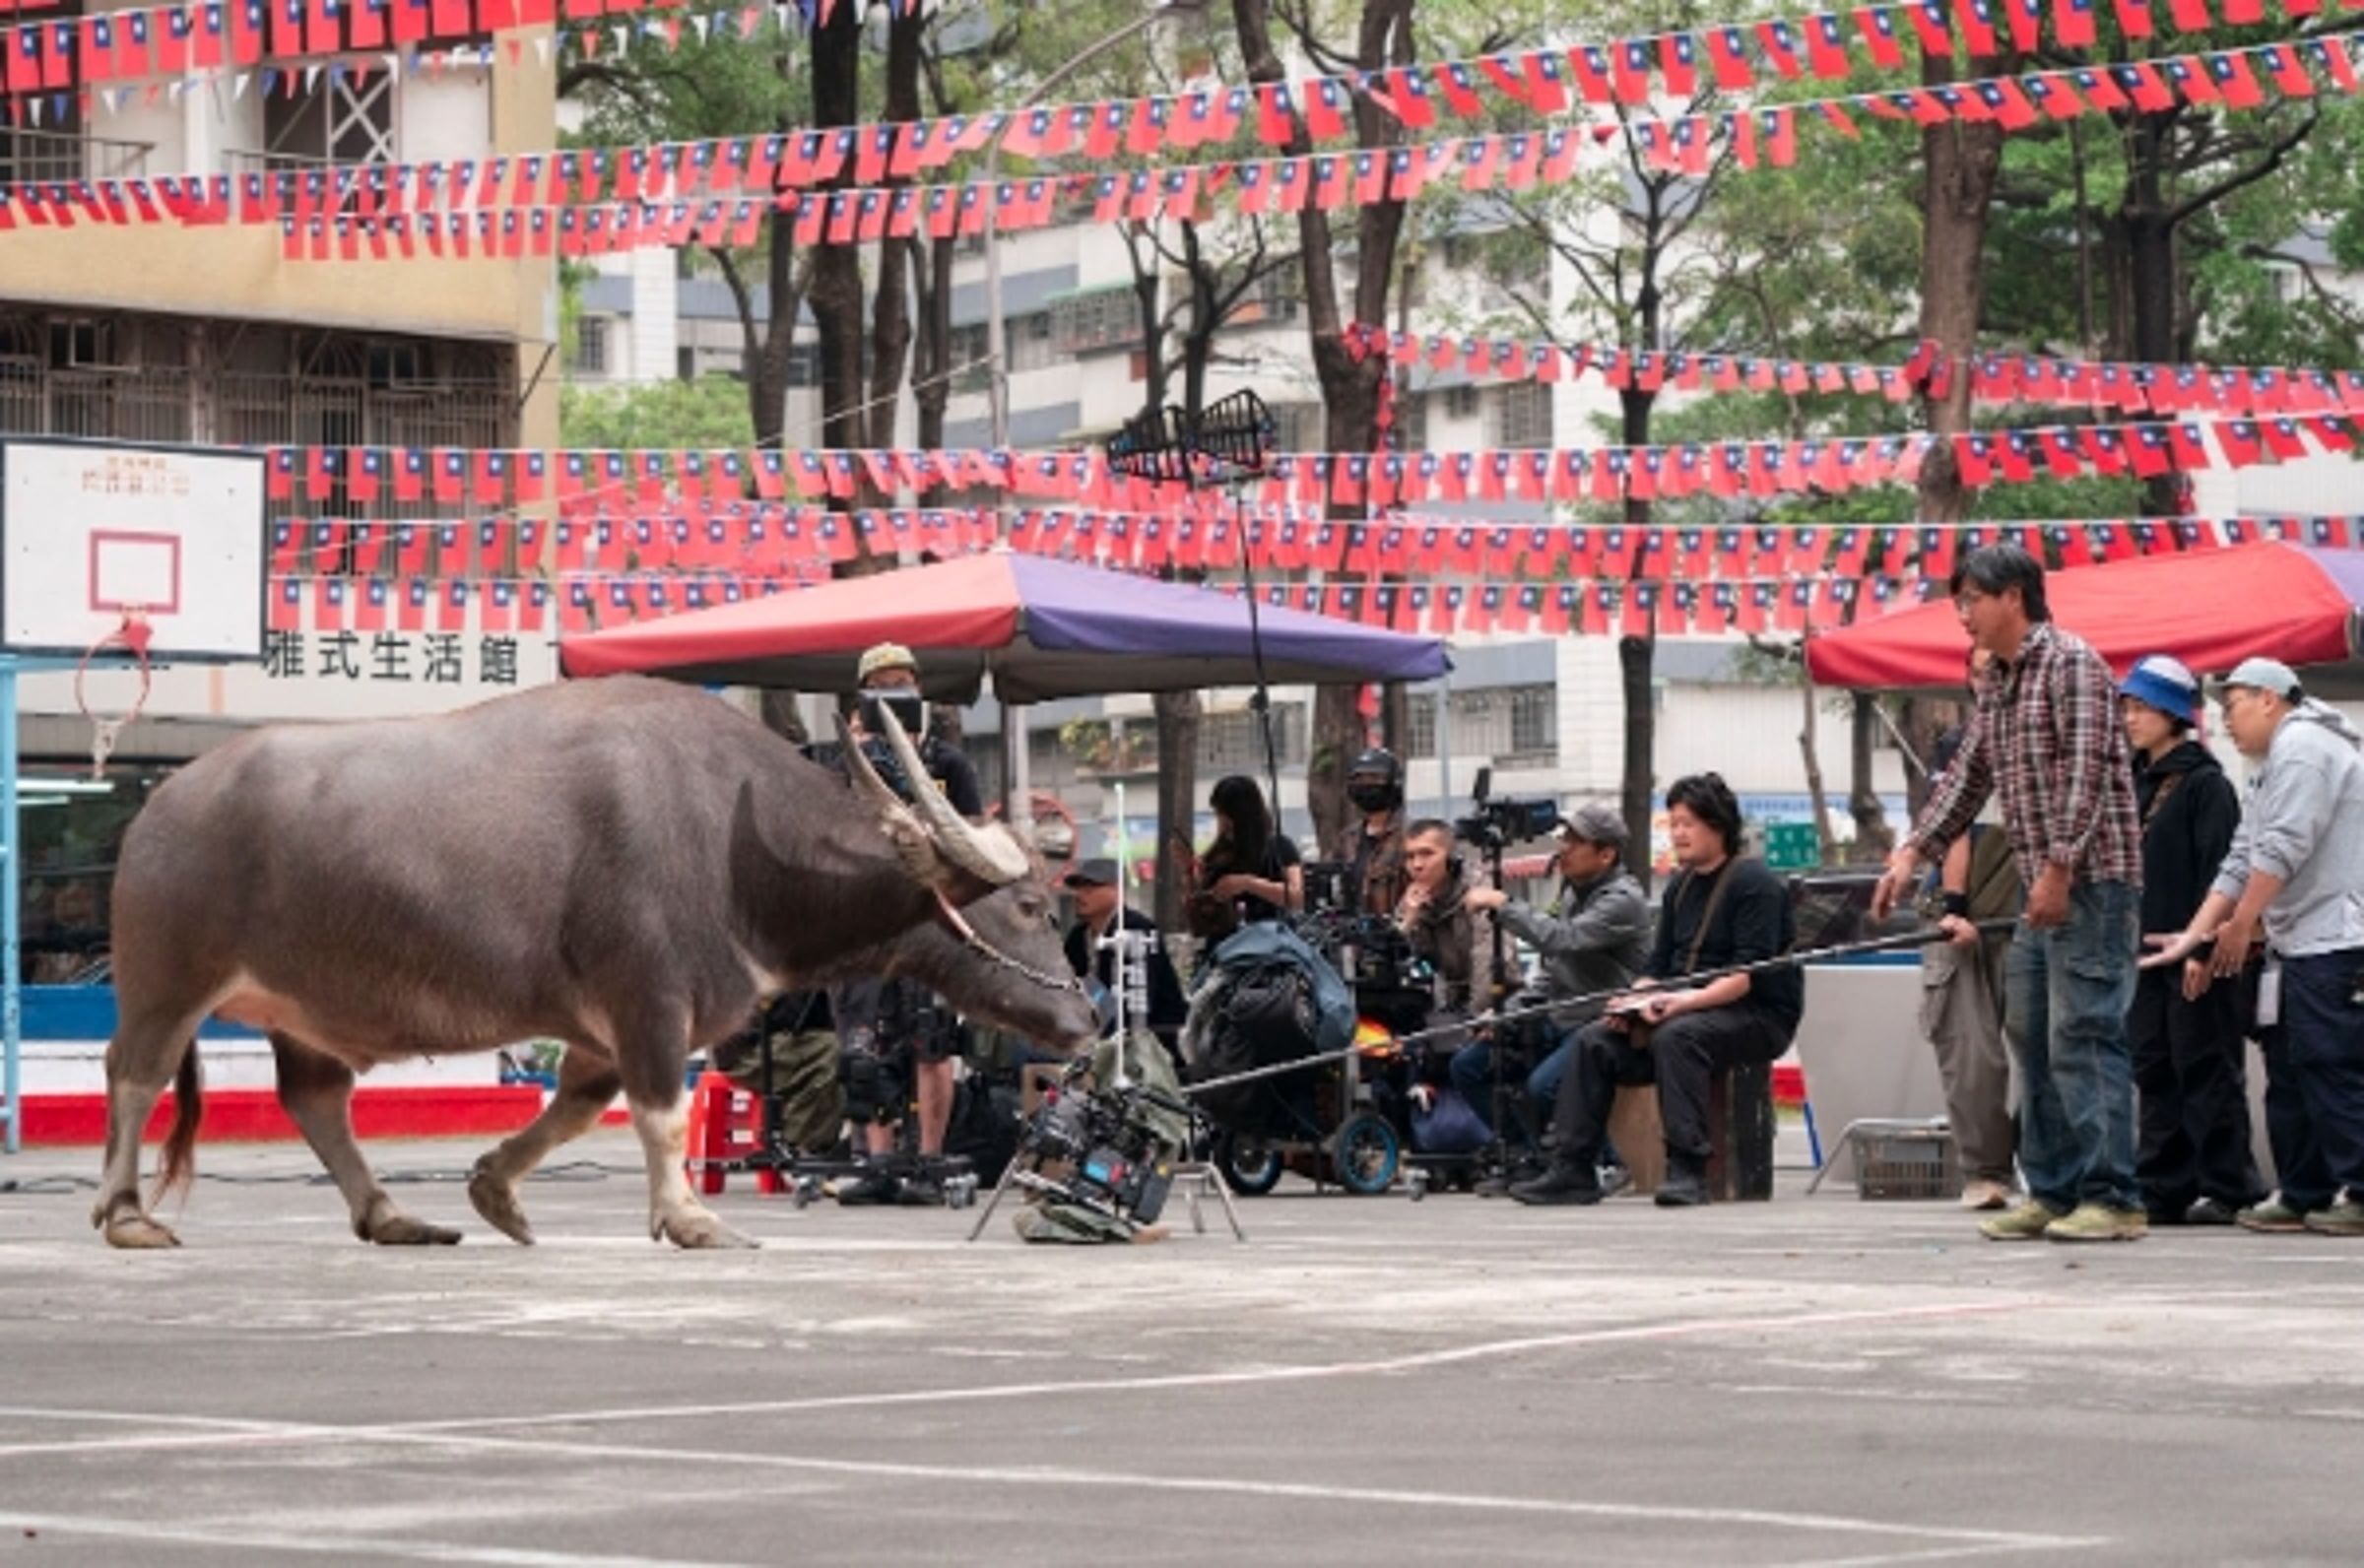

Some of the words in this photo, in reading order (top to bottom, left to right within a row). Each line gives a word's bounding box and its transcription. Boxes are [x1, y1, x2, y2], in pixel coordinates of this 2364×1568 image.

[263, 630, 517, 684] 雅式生活館
